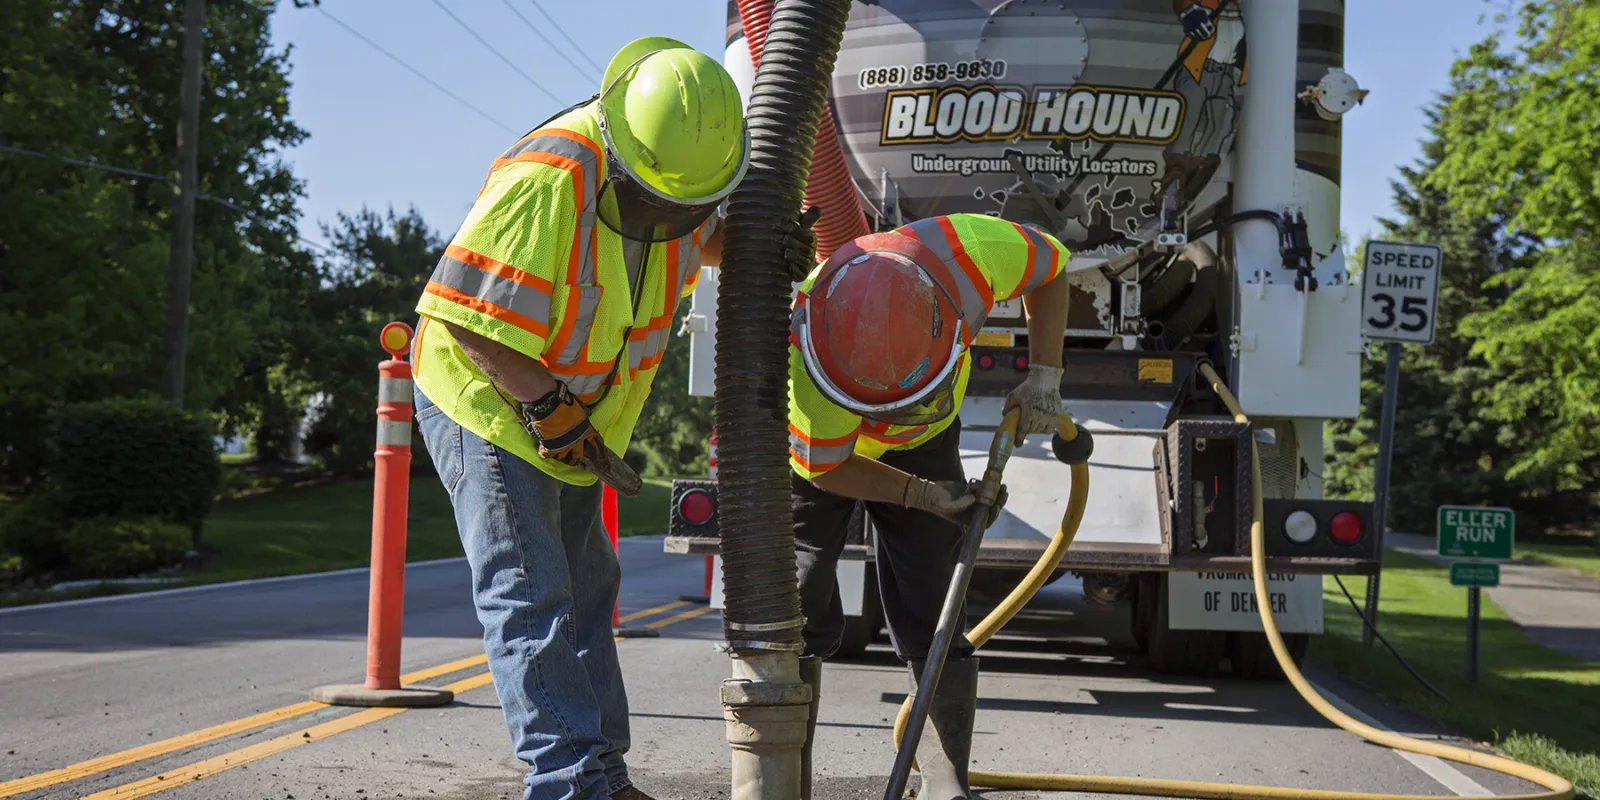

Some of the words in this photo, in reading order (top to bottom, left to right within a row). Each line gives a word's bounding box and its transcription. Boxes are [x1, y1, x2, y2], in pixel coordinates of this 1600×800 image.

[860, 66, 906, 88] (888)
[912, 60, 1006, 82] 858-9830
[886, 90, 1024, 139] BLOOD
[1030, 89, 1181, 139] HOUND
[912, 154, 1022, 174] Undergroun
[1025, 155, 1079, 174] Utility
[1083, 157, 1156, 174] Locators
[1371, 251, 1434, 269] SPEED
[1376, 273, 1426, 290] LIMIT
[1367, 293, 1428, 333] 35
[1445, 510, 1506, 529] ELLER
[1456, 527, 1496, 543] RUN
[1204, 591, 1221, 612] OF
[1231, 592, 1287, 613] DENER
